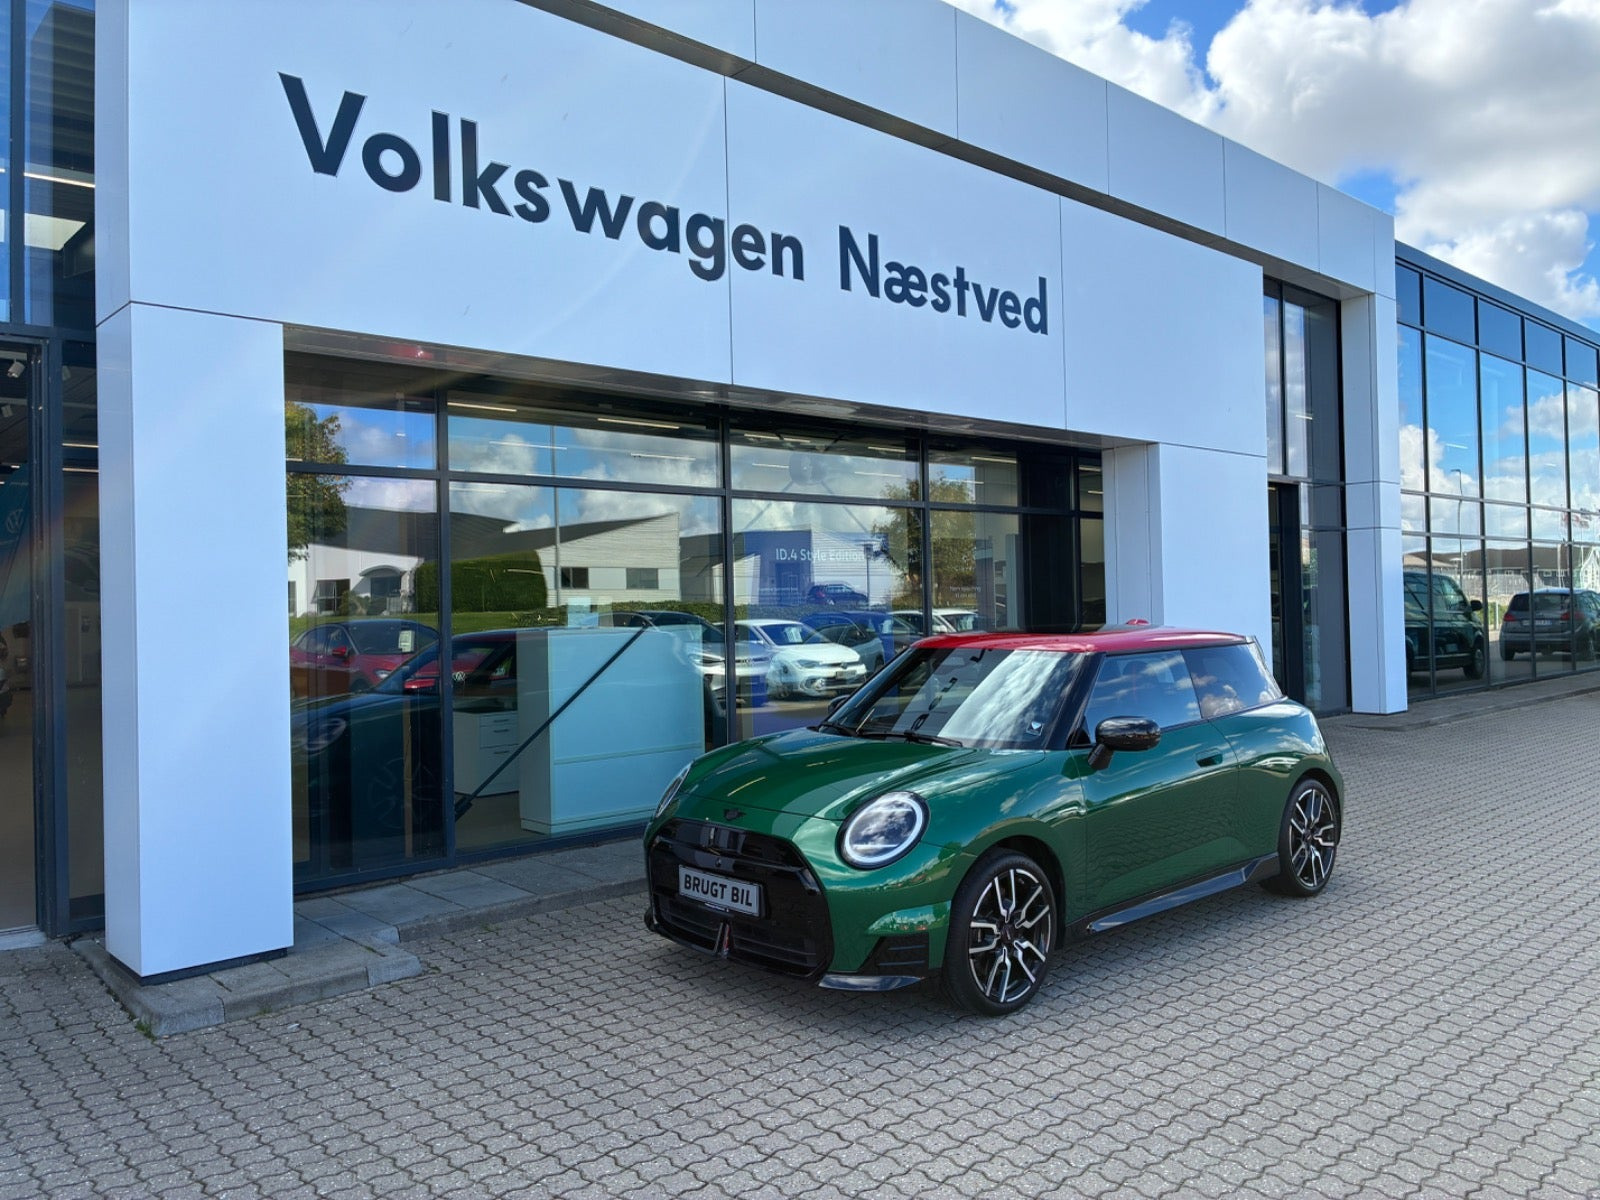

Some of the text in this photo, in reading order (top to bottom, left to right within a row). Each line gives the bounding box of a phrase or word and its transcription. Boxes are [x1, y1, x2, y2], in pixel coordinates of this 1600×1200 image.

[278, 72, 1048, 336] Volkswagen Næstved
[776, 549, 798, 561] ID.4
[684, 874, 752, 907] BRUGT BIL
